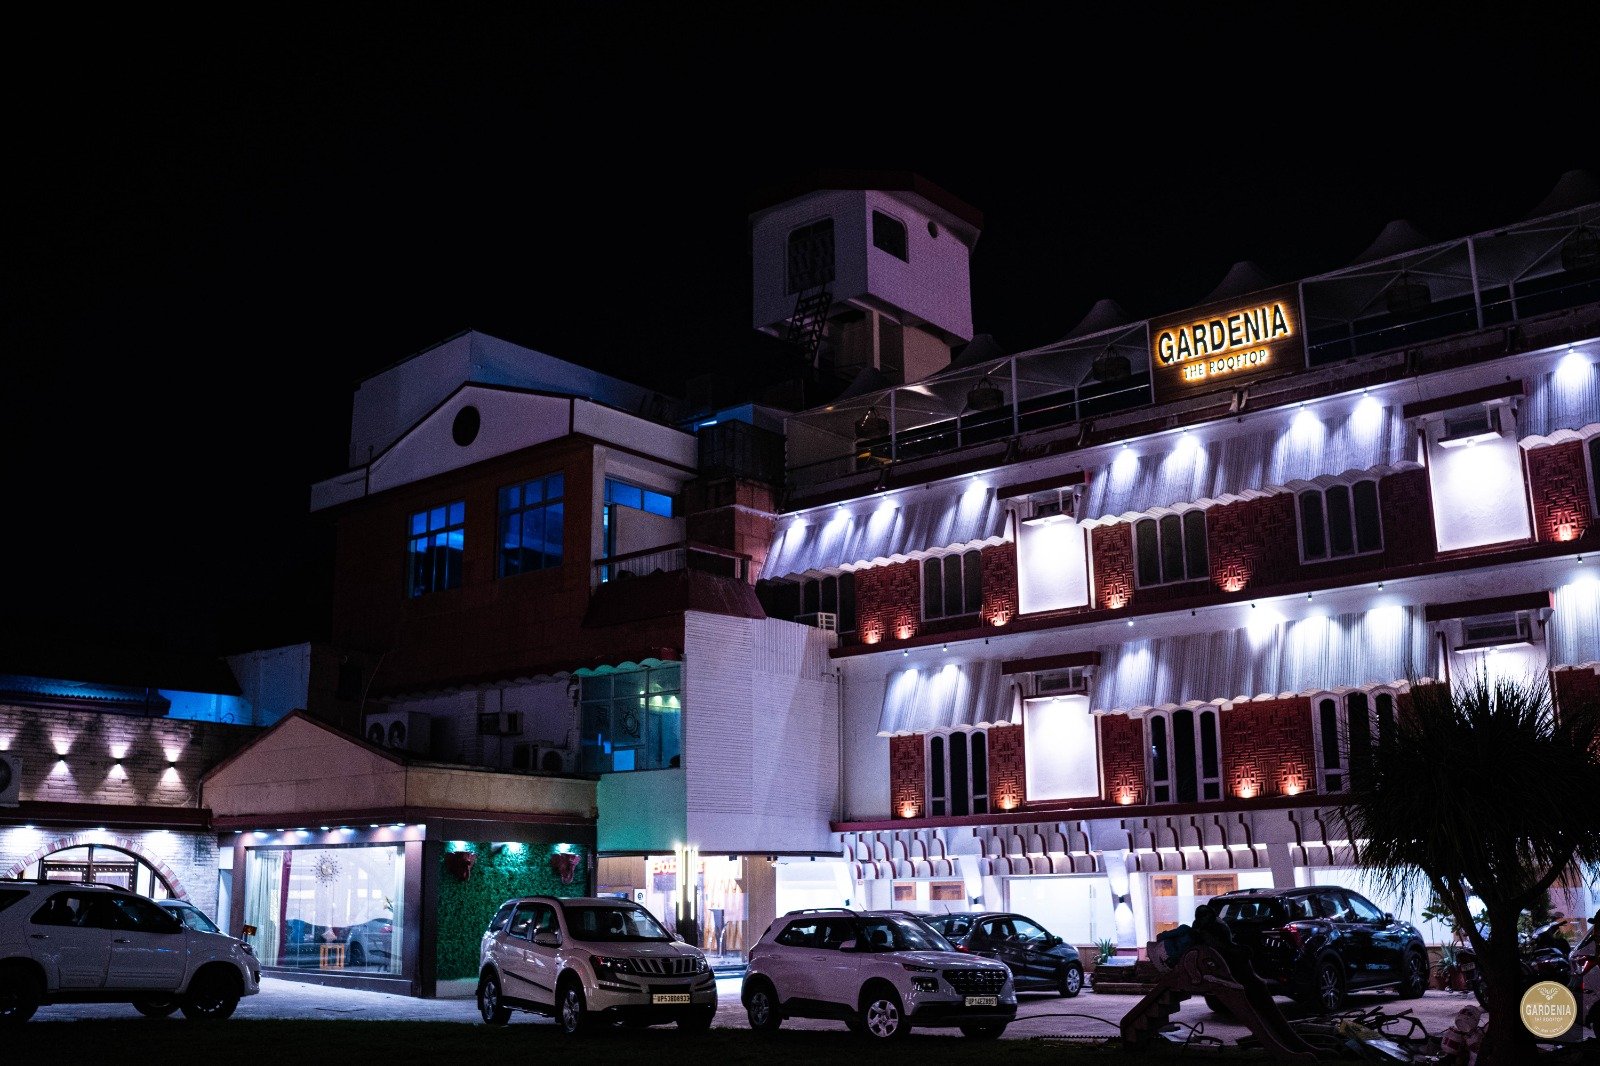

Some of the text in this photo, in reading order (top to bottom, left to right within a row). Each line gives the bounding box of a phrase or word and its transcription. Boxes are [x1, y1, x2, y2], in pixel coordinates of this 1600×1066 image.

[1158, 304, 1288, 364] GARDENIA
[1183, 349, 1266, 379] THE ROOFTOP
